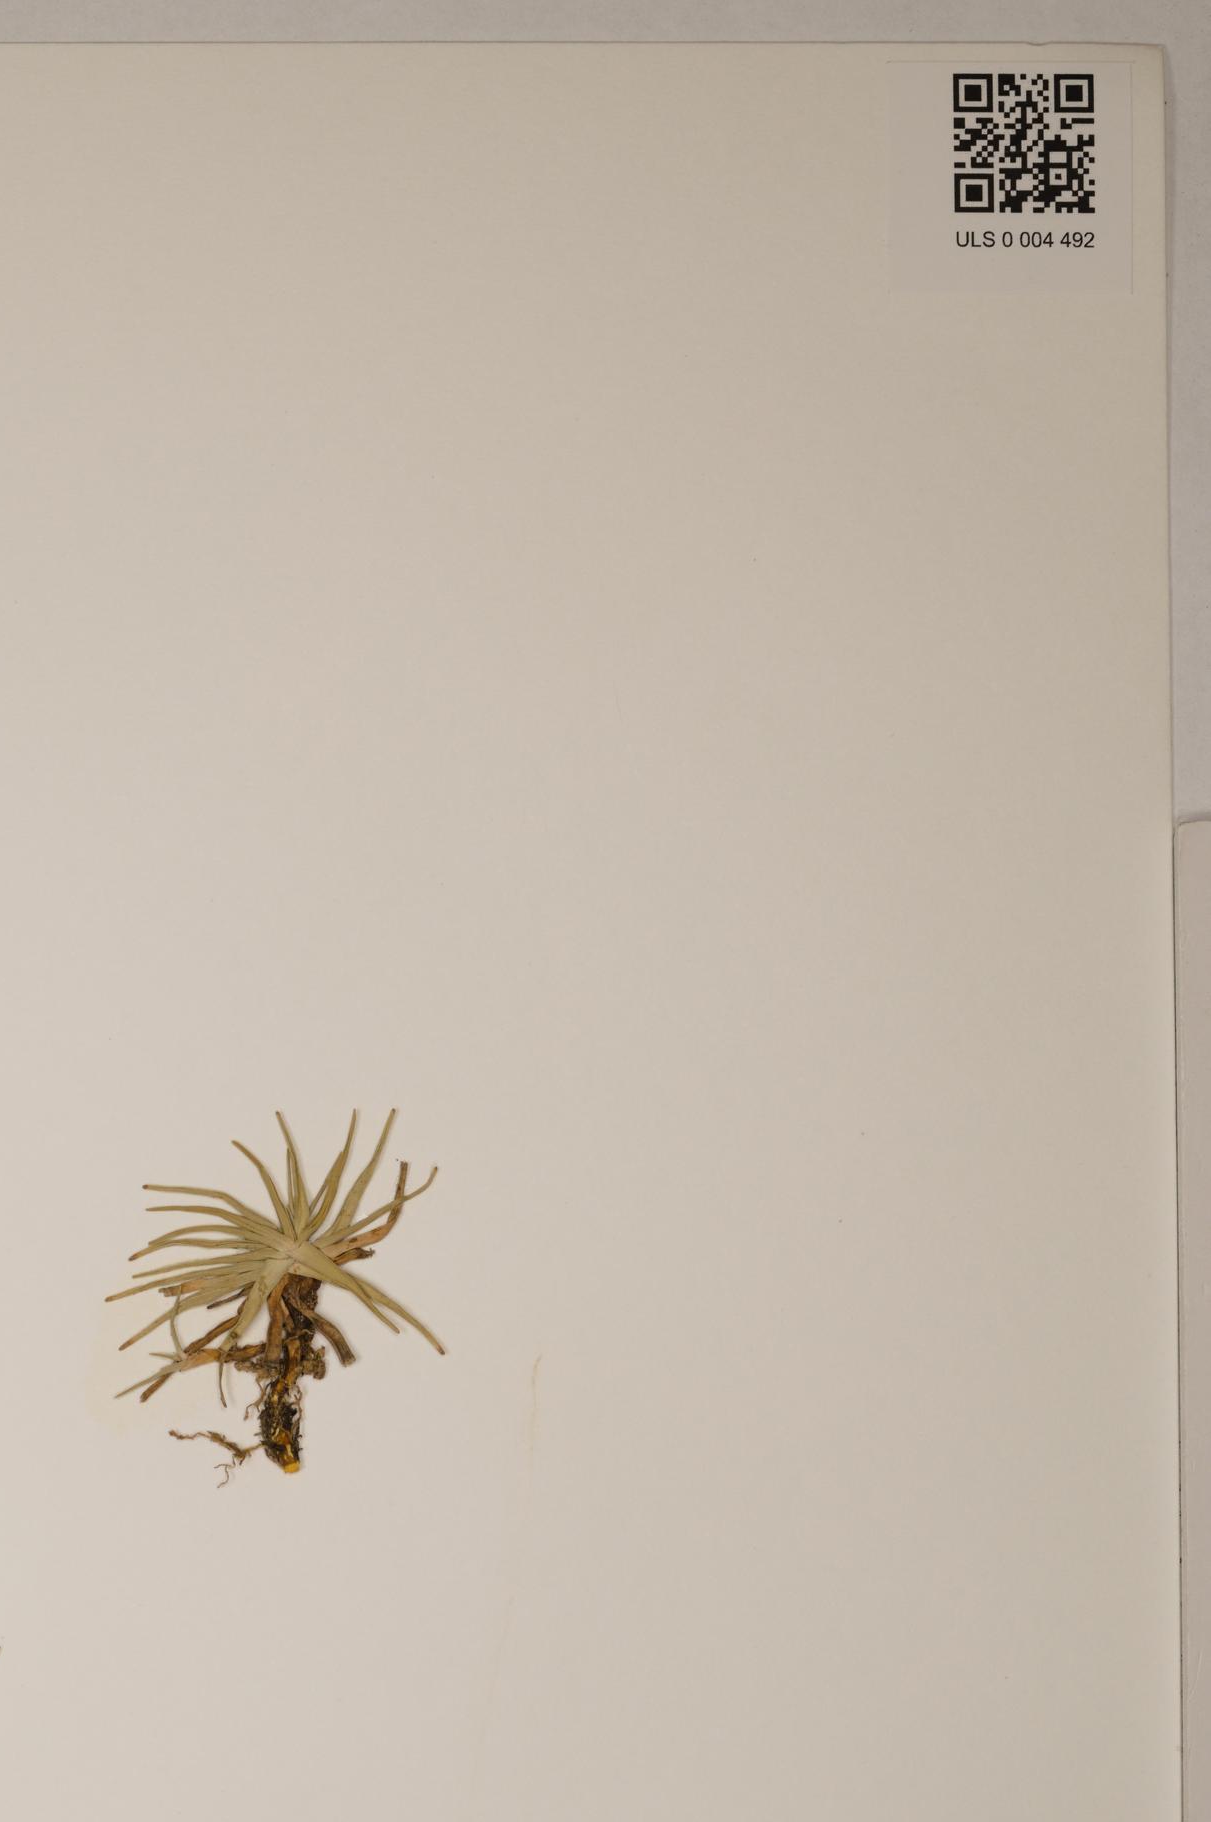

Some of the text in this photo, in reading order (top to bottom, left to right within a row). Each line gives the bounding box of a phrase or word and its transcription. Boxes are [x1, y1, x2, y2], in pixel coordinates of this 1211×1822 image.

[956, 231, 1095, 249] ULS 0 004 492
